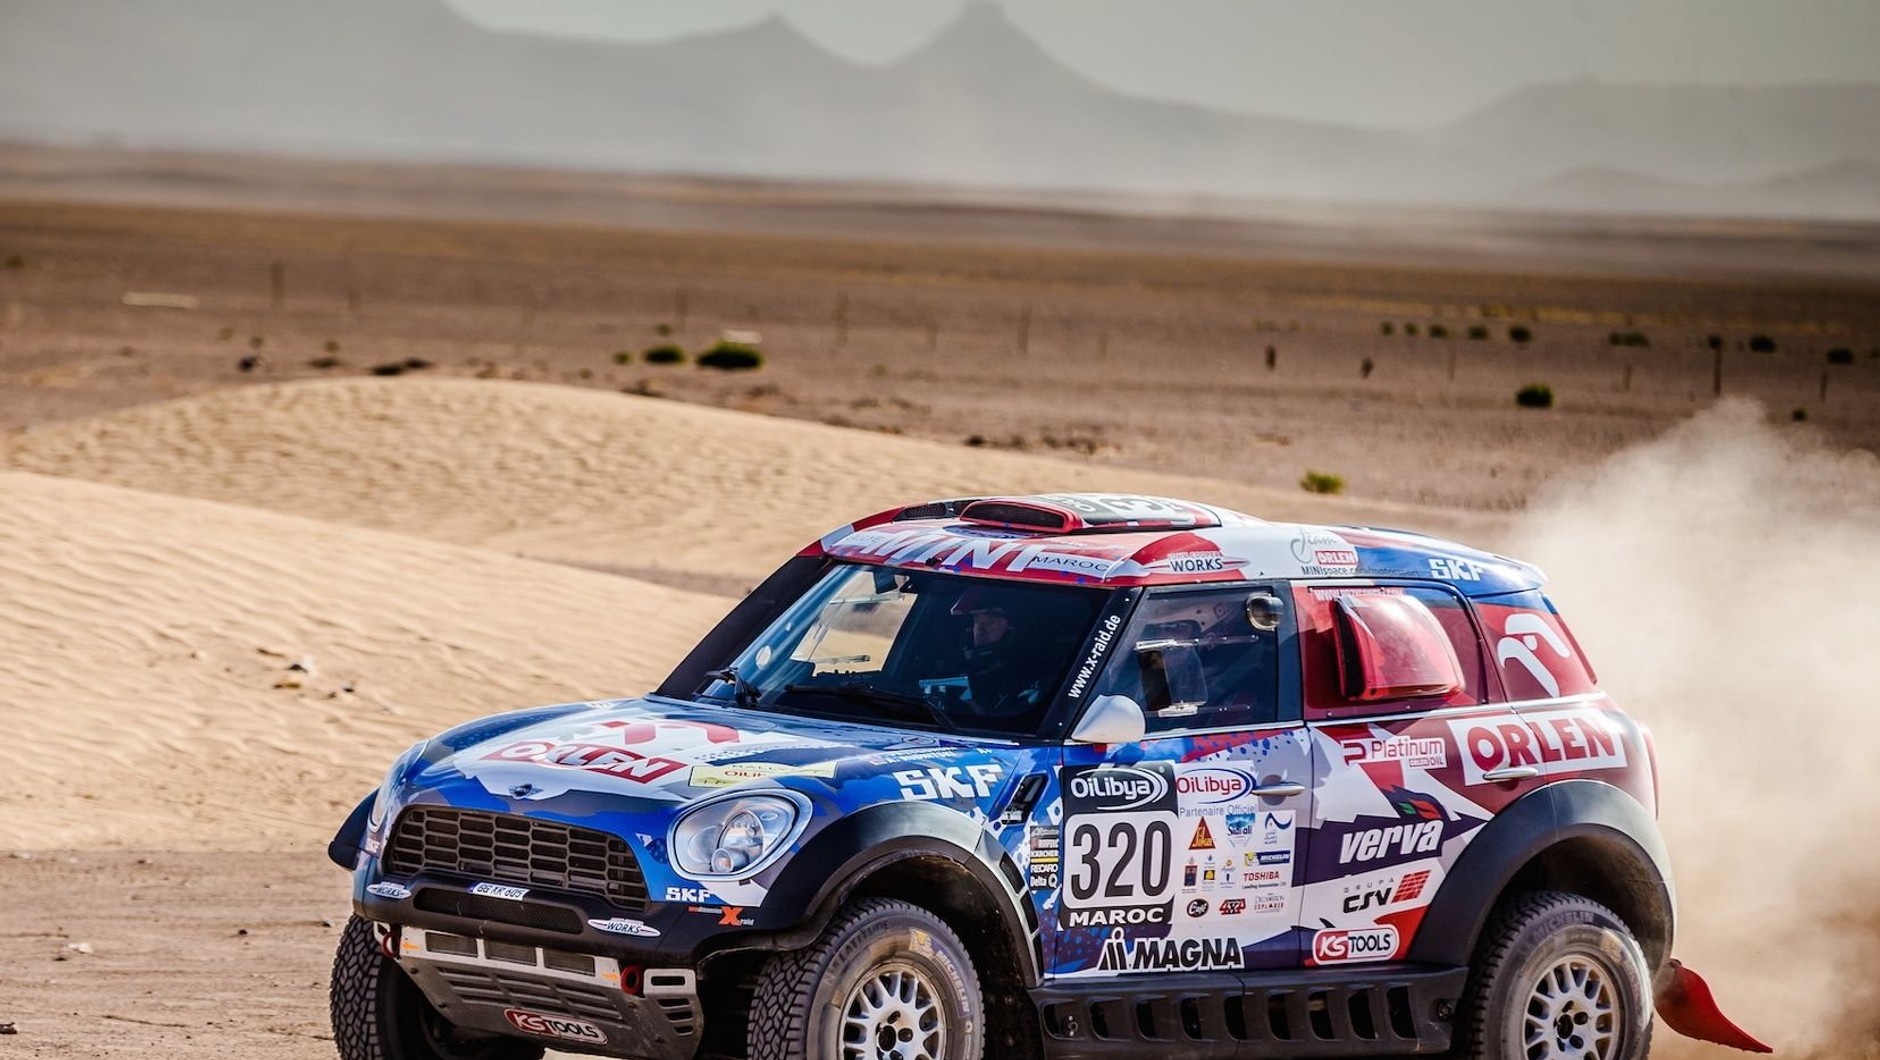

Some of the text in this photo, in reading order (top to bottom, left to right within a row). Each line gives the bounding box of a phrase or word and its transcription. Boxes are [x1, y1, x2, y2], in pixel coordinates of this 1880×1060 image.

[1032, 555, 1110, 572] MAROC
[1171, 558, 1223, 572] WORKS
[1316, 551, 1355, 564] ORLEN
[1428, 558, 1485, 581] SKF
[1068, 615, 1122, 698] www.x-raid.de
[1371, 739, 1444, 758] Platinum
[1467, 717, 1616, 772] ORLEN
[500, 742, 666, 778] ORLEN
[1430, 756, 1445, 767] OIL
[892, 763, 1003, 800] SKF
[1070, 776, 1152, 800] OiLibya
[1176, 776, 1242, 796] OiLibya
[1180, 804, 1257, 818] Partenaire Officiel
[1339, 819, 1444, 864] verva
[1071, 820, 1172, 899] 320
[1260, 853, 1290, 862] MICHELIN
[1031, 864, 1059, 873] RECARO
[1244, 871, 1280, 882] TOSHIBA
[1030, 876, 1047, 887] Delta
[1344, 877, 1395, 893] GRUPA
[377, 887, 400, 897] WORKS
[505, 889, 524, 898] 605
[665, 886, 711, 903] SKF
[1343, 888, 1392, 914] CSV
[606, 921, 641, 935] WORKS
[1069, 908, 1164, 928] MAROC
[1535, 911, 1594, 938] MICHELIN
[1348, 933, 1392, 953] TOOLS
[1132, 938, 1242, 970] MAGNA
[936, 950, 971, 1013] MICHELIN
[545, 1018, 599, 1039] TOOLS
